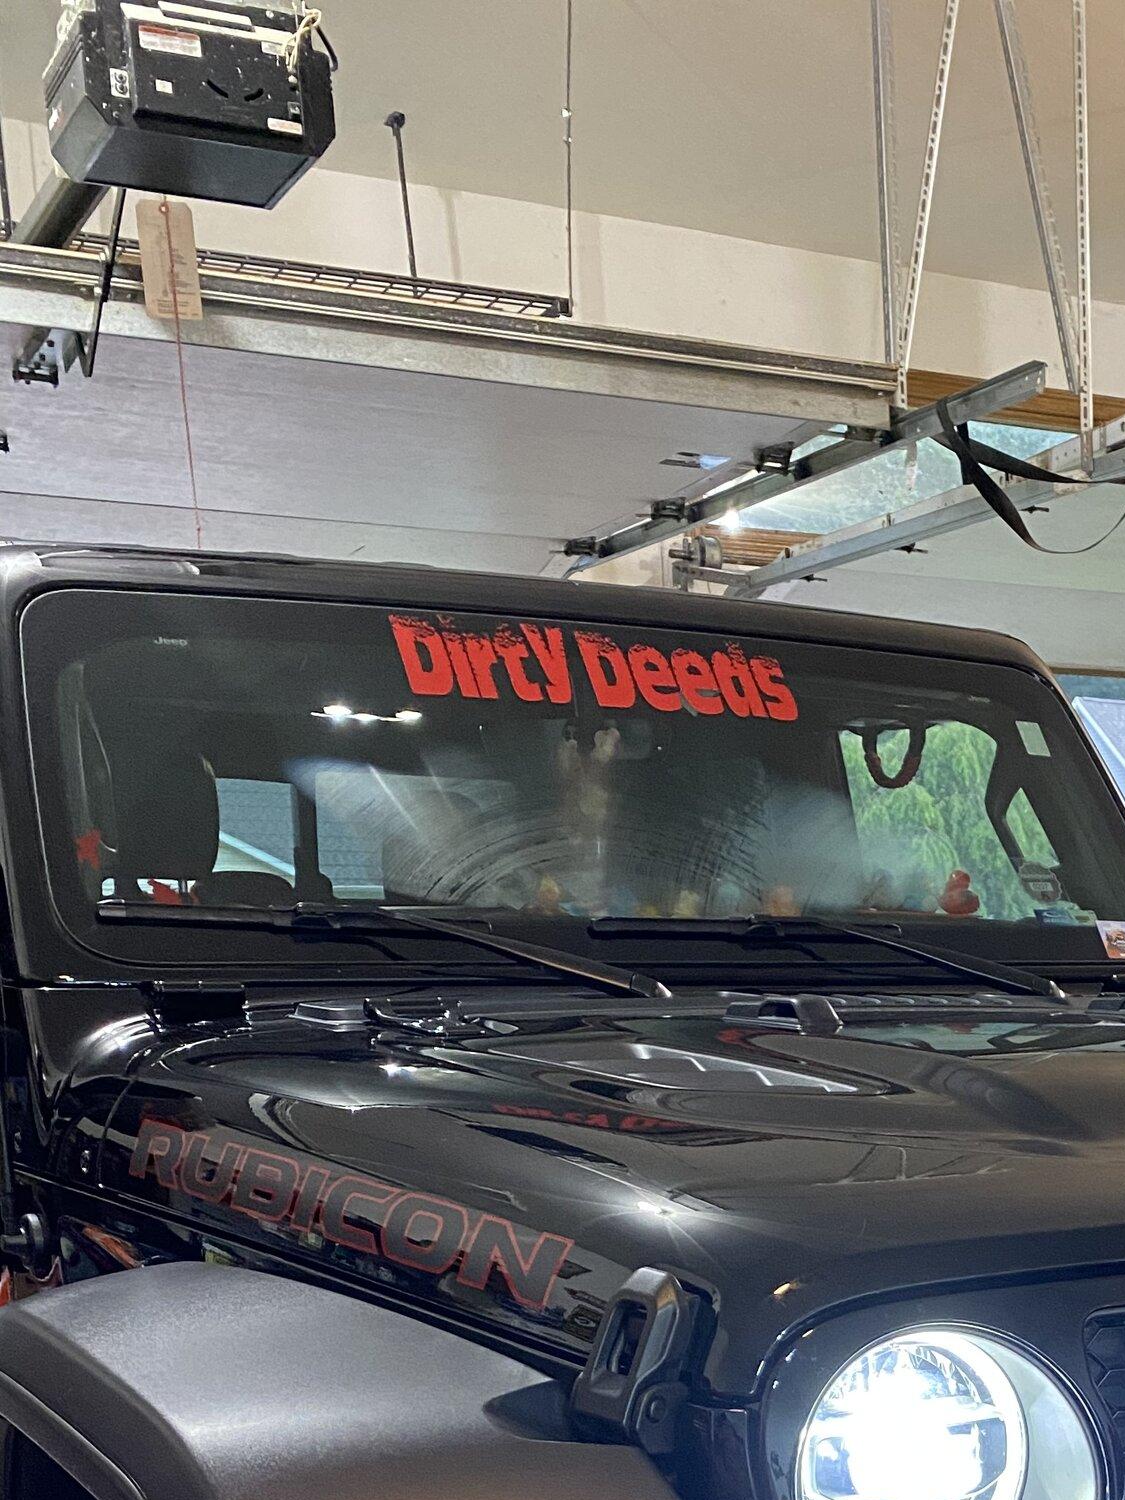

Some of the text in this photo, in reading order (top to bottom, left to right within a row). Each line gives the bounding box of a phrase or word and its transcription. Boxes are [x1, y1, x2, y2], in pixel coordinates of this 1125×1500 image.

[388, 614, 798, 721] Dirty Deeds
[129, 1117, 575, 1311] RUBICON
